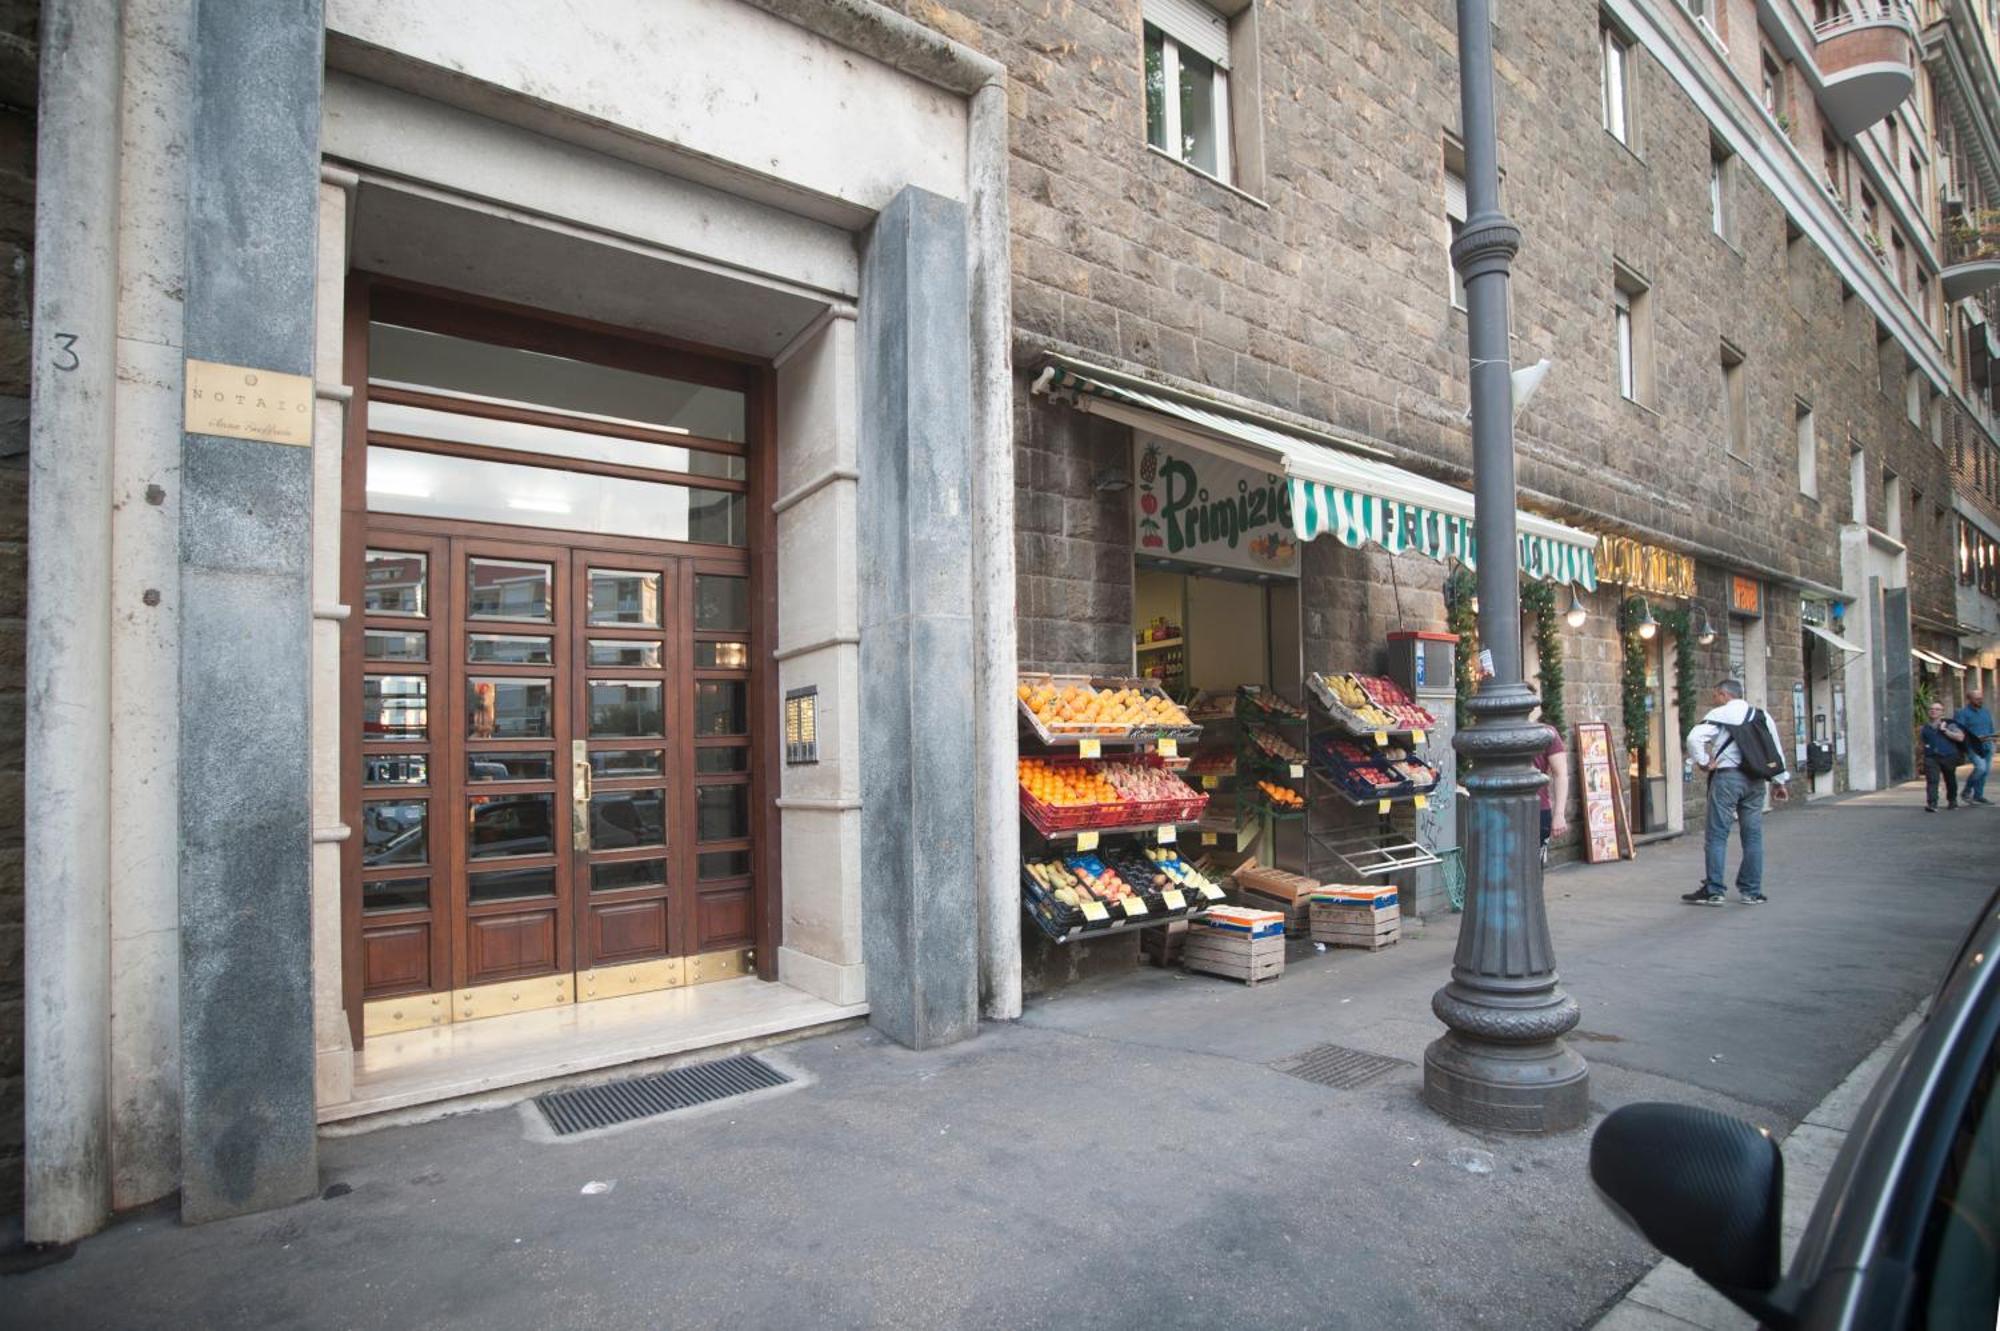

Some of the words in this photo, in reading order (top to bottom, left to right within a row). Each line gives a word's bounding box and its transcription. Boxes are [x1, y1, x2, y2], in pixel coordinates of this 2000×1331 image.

[52, 332, 80, 372] 3
[192, 388, 306, 413] NOTAIO
[1158, 455, 1294, 554] Primizie
